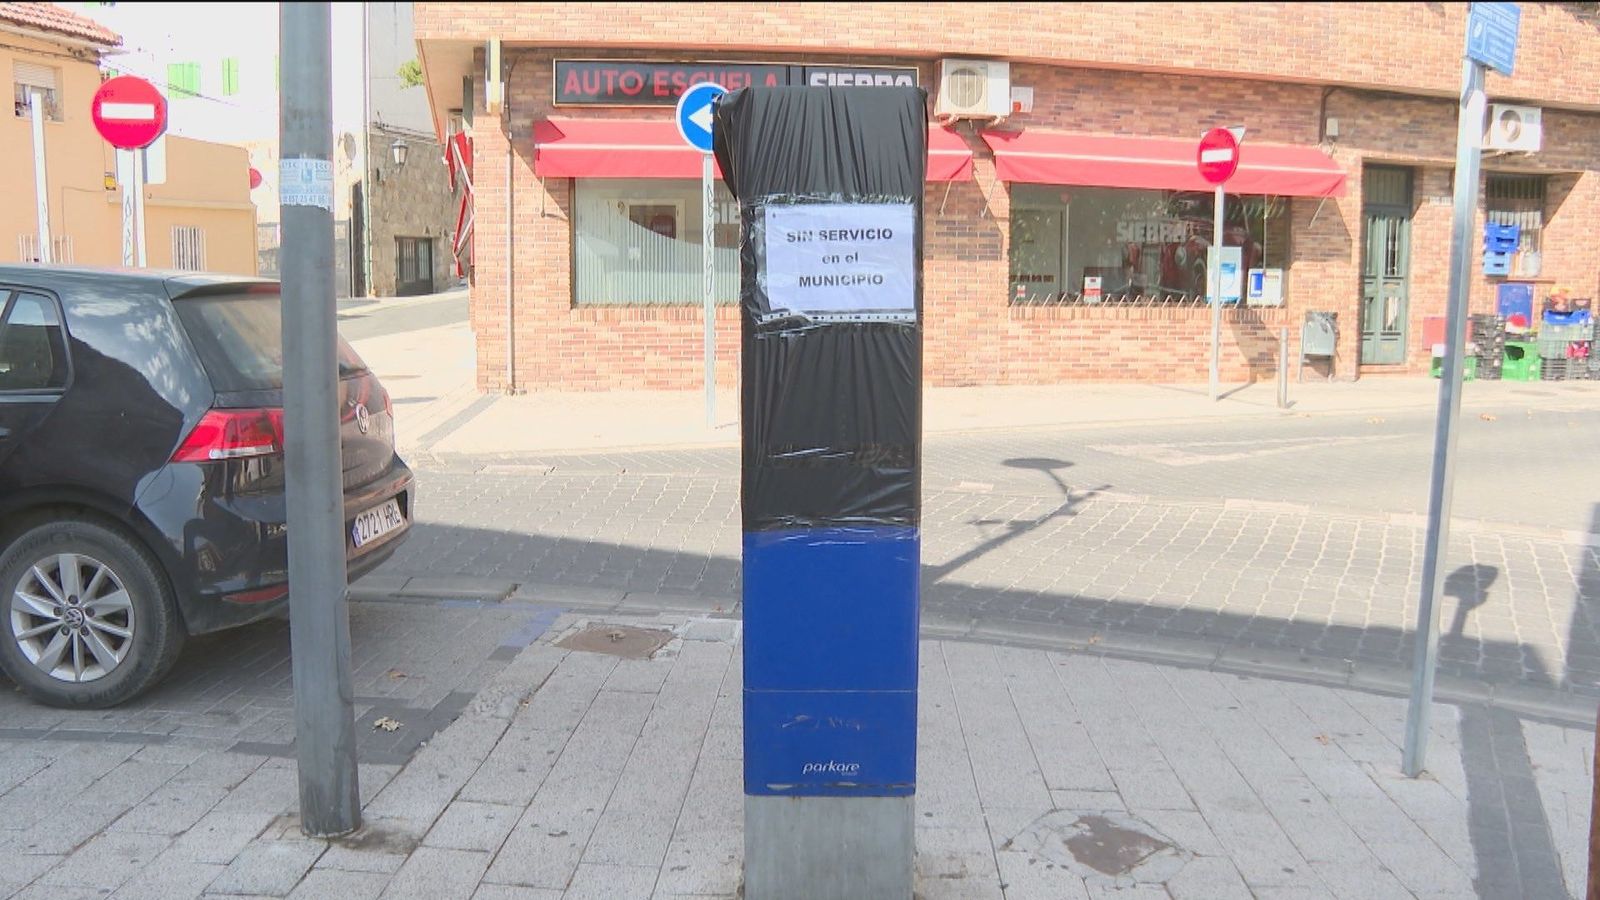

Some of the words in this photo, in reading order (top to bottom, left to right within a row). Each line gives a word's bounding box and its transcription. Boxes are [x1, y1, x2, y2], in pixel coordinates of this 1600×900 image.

[564, 69, 644, 96] AUTO
[786, 230, 813, 243] SIN
[818, 228, 893, 241] SERVICIO
[822, 254, 840, 264] en
[845, 252, 859, 264] el
[799, 274, 884, 288] MUNICIPIO
[359, 509, 384, 540] 2721
[803, 760, 860, 775] parkare
